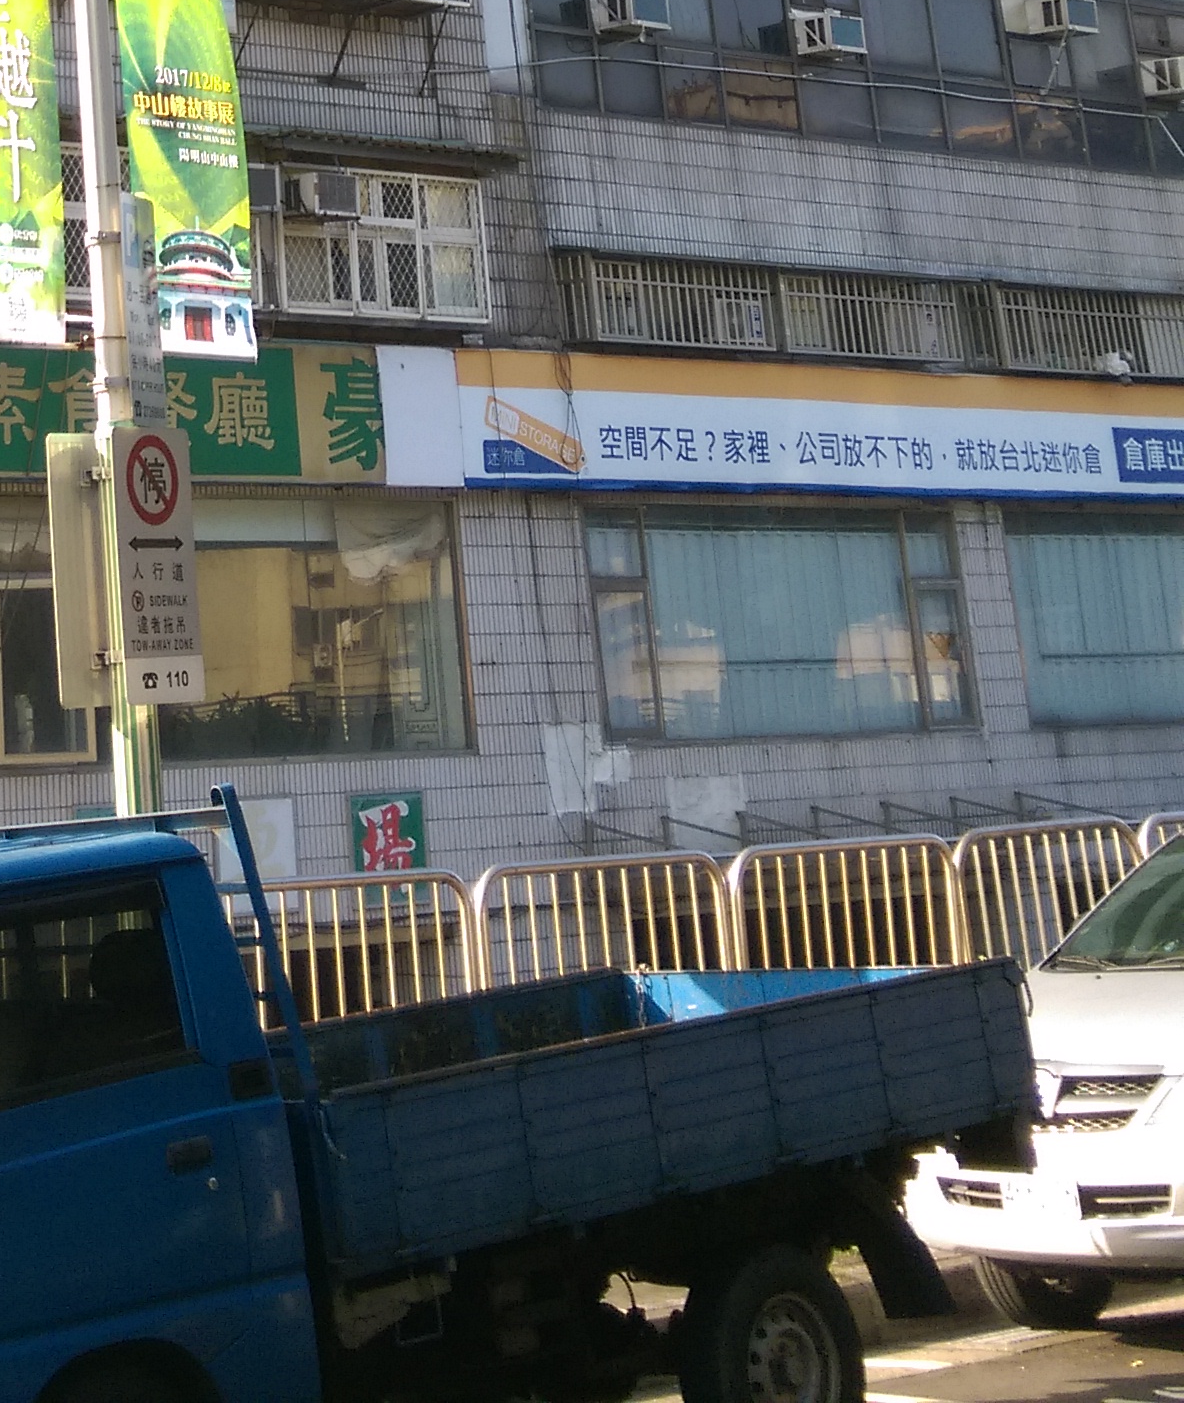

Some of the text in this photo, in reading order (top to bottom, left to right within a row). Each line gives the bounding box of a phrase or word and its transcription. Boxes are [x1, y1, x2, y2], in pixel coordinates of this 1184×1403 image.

[133, 91, 235, 125] 中山樓故事展
[519, 421, 576, 463] STORAGE
[132, 562, 185, 582] 人行道
[149, 595, 188, 607] SIDEWALK
[137, 615, 186, 634] 違者拖吊
[131, 638, 194, 652] TOW-AWAY ZONE
[166, 670, 189, 688] 110
